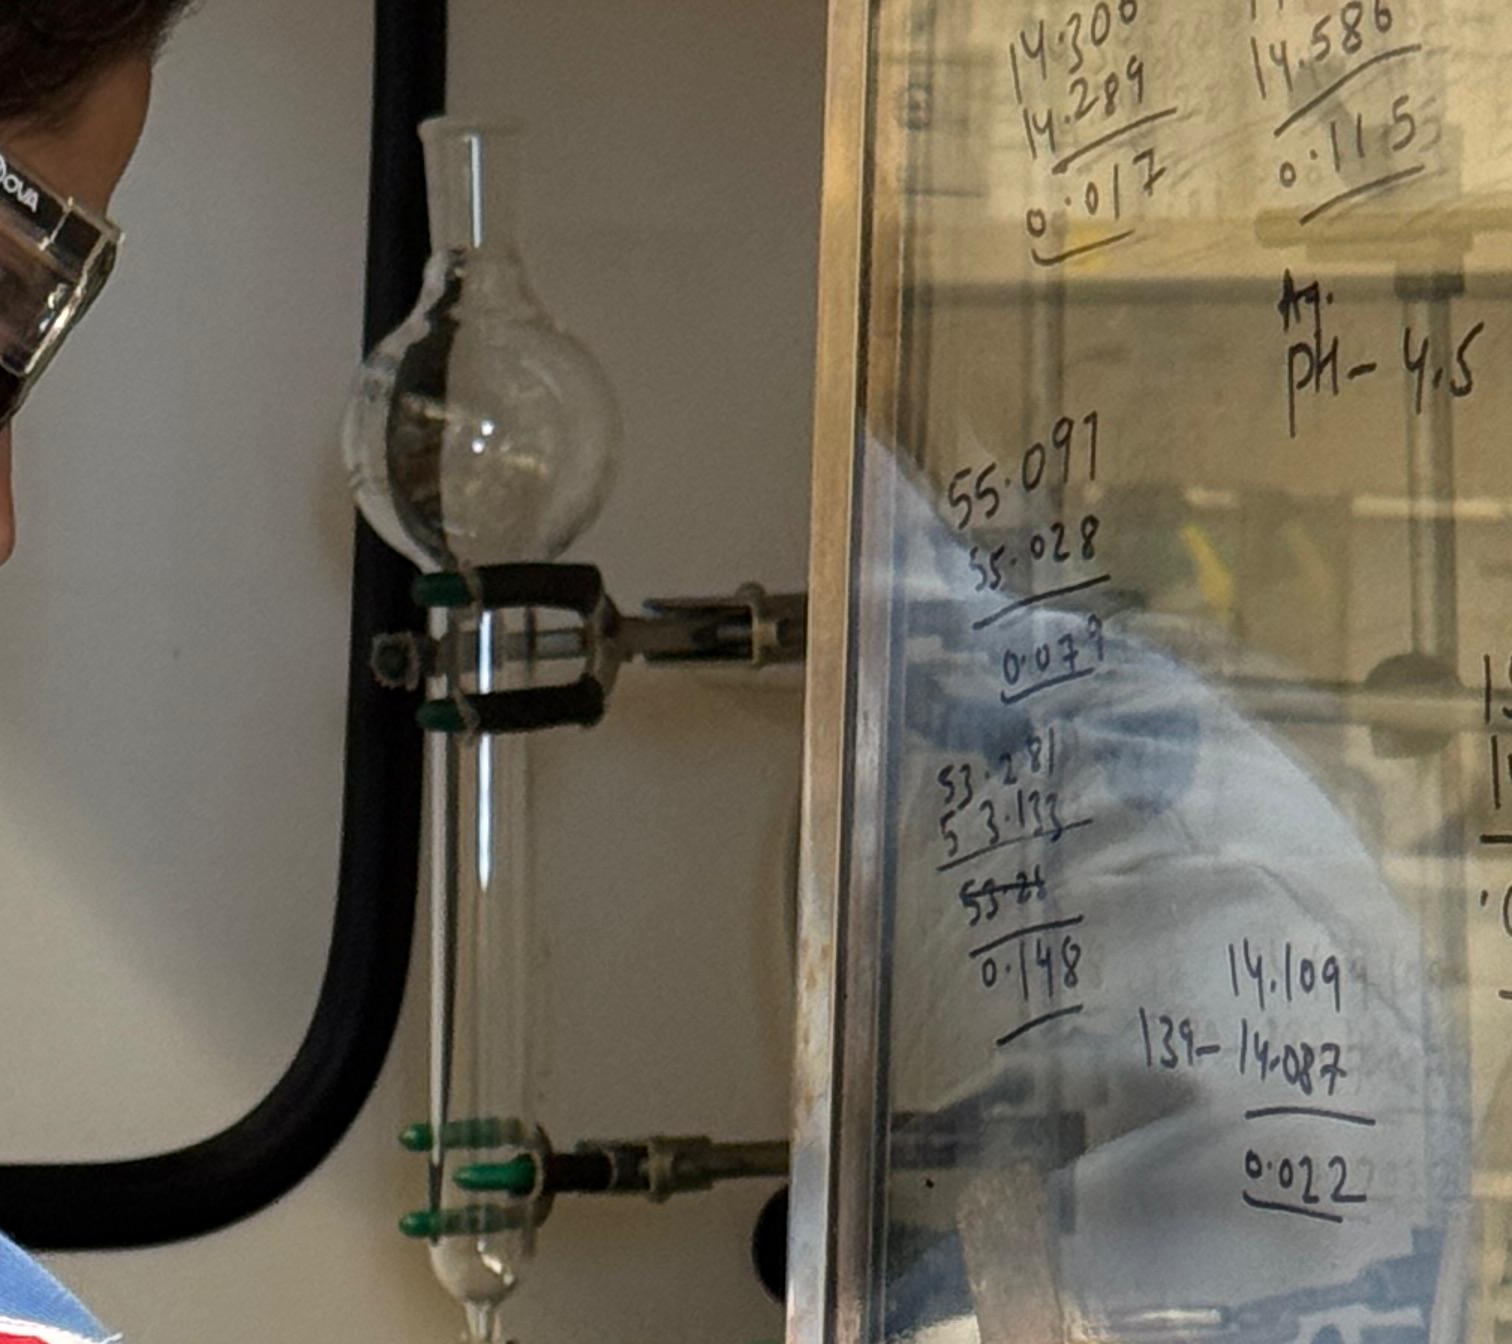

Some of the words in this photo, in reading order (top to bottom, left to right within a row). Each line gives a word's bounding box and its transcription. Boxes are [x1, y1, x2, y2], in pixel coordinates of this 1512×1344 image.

[1022, 54, 1145, 161] 14.289
[1278, 93, 1417, 189] 0.115
[1025, 147, 1167, 238] 0.017
[1402, 320, 1486, 416] 4.5
[981, 935, 1083, 1002] 0.148
[1228, 937, 1342, 1013] 14.109
[1244, 1148, 1368, 1205] 0.022
